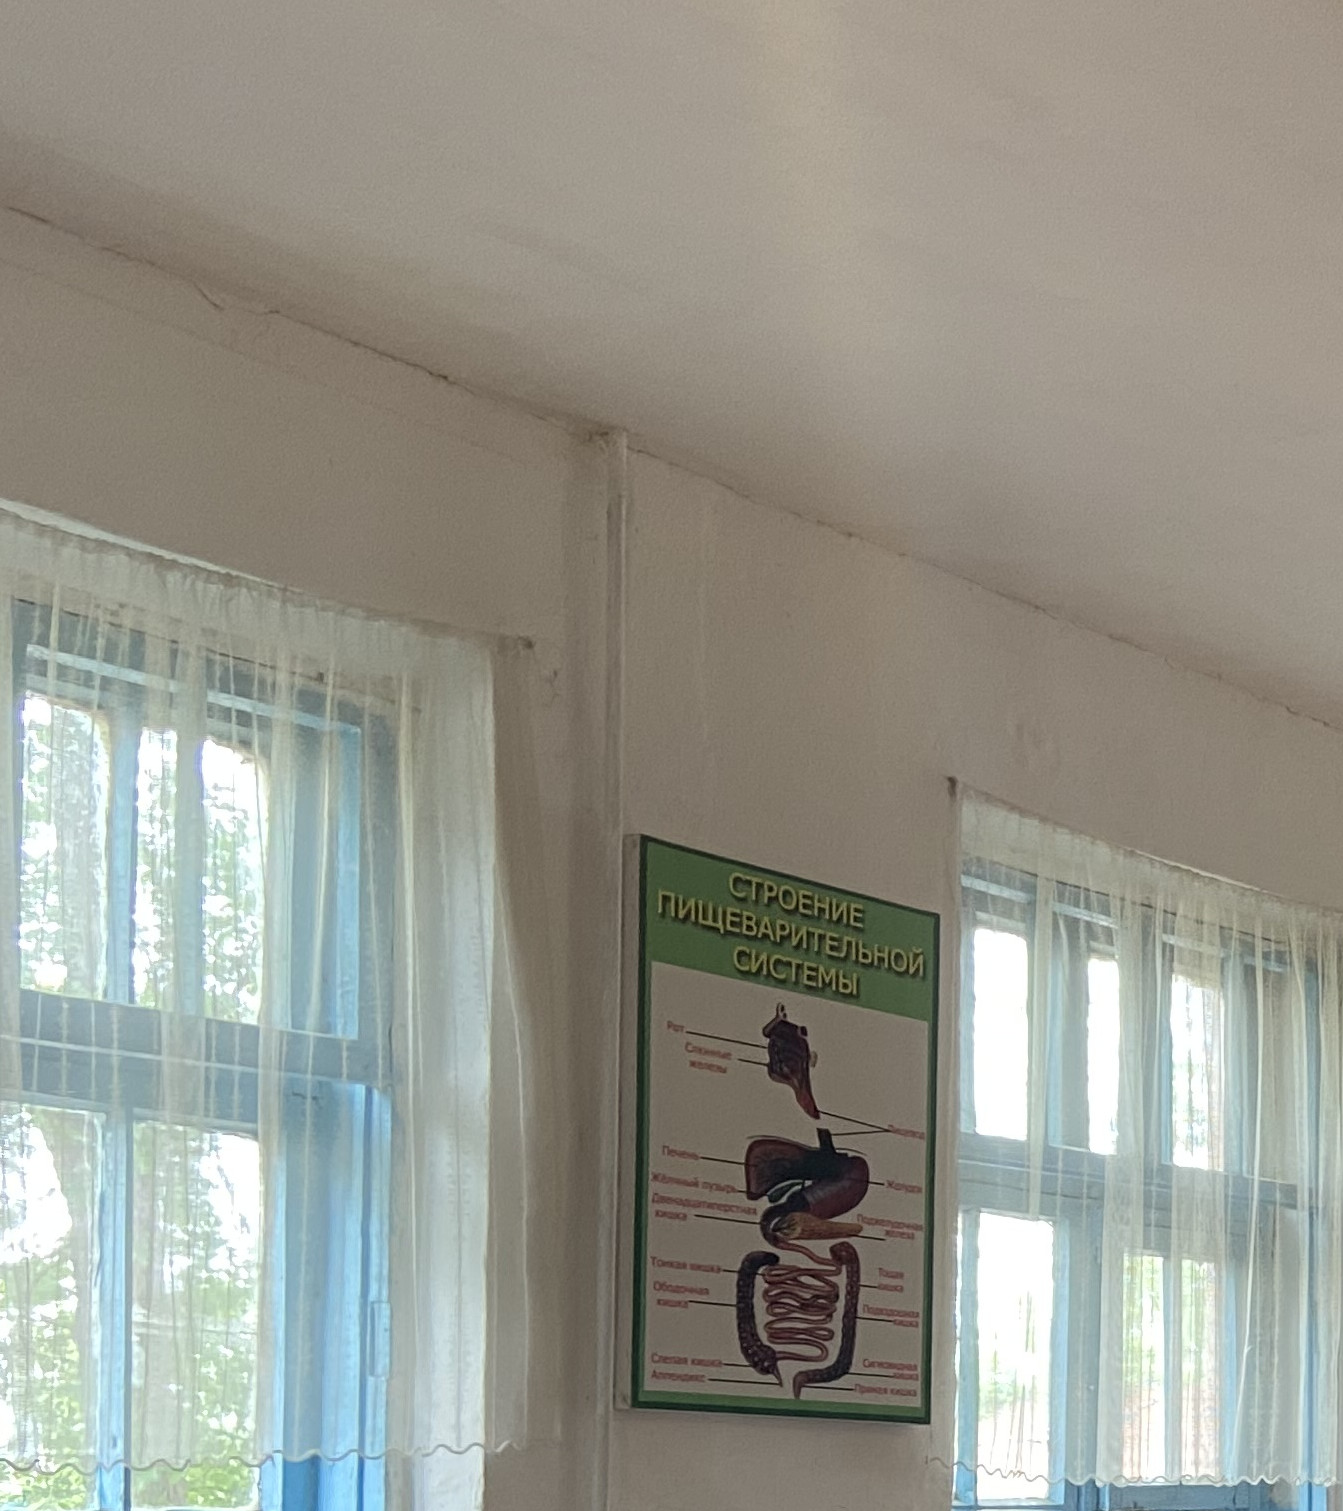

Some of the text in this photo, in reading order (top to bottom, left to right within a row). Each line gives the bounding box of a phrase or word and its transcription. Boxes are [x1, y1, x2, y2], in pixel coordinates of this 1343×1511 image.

[729, 872, 864, 928] СТРОЕНИЕ
[658, 889, 925, 977] ПИЩЕВАРИТЕЛЬНОЙ
[733, 945, 859, 995] СИСТЕМЫ
